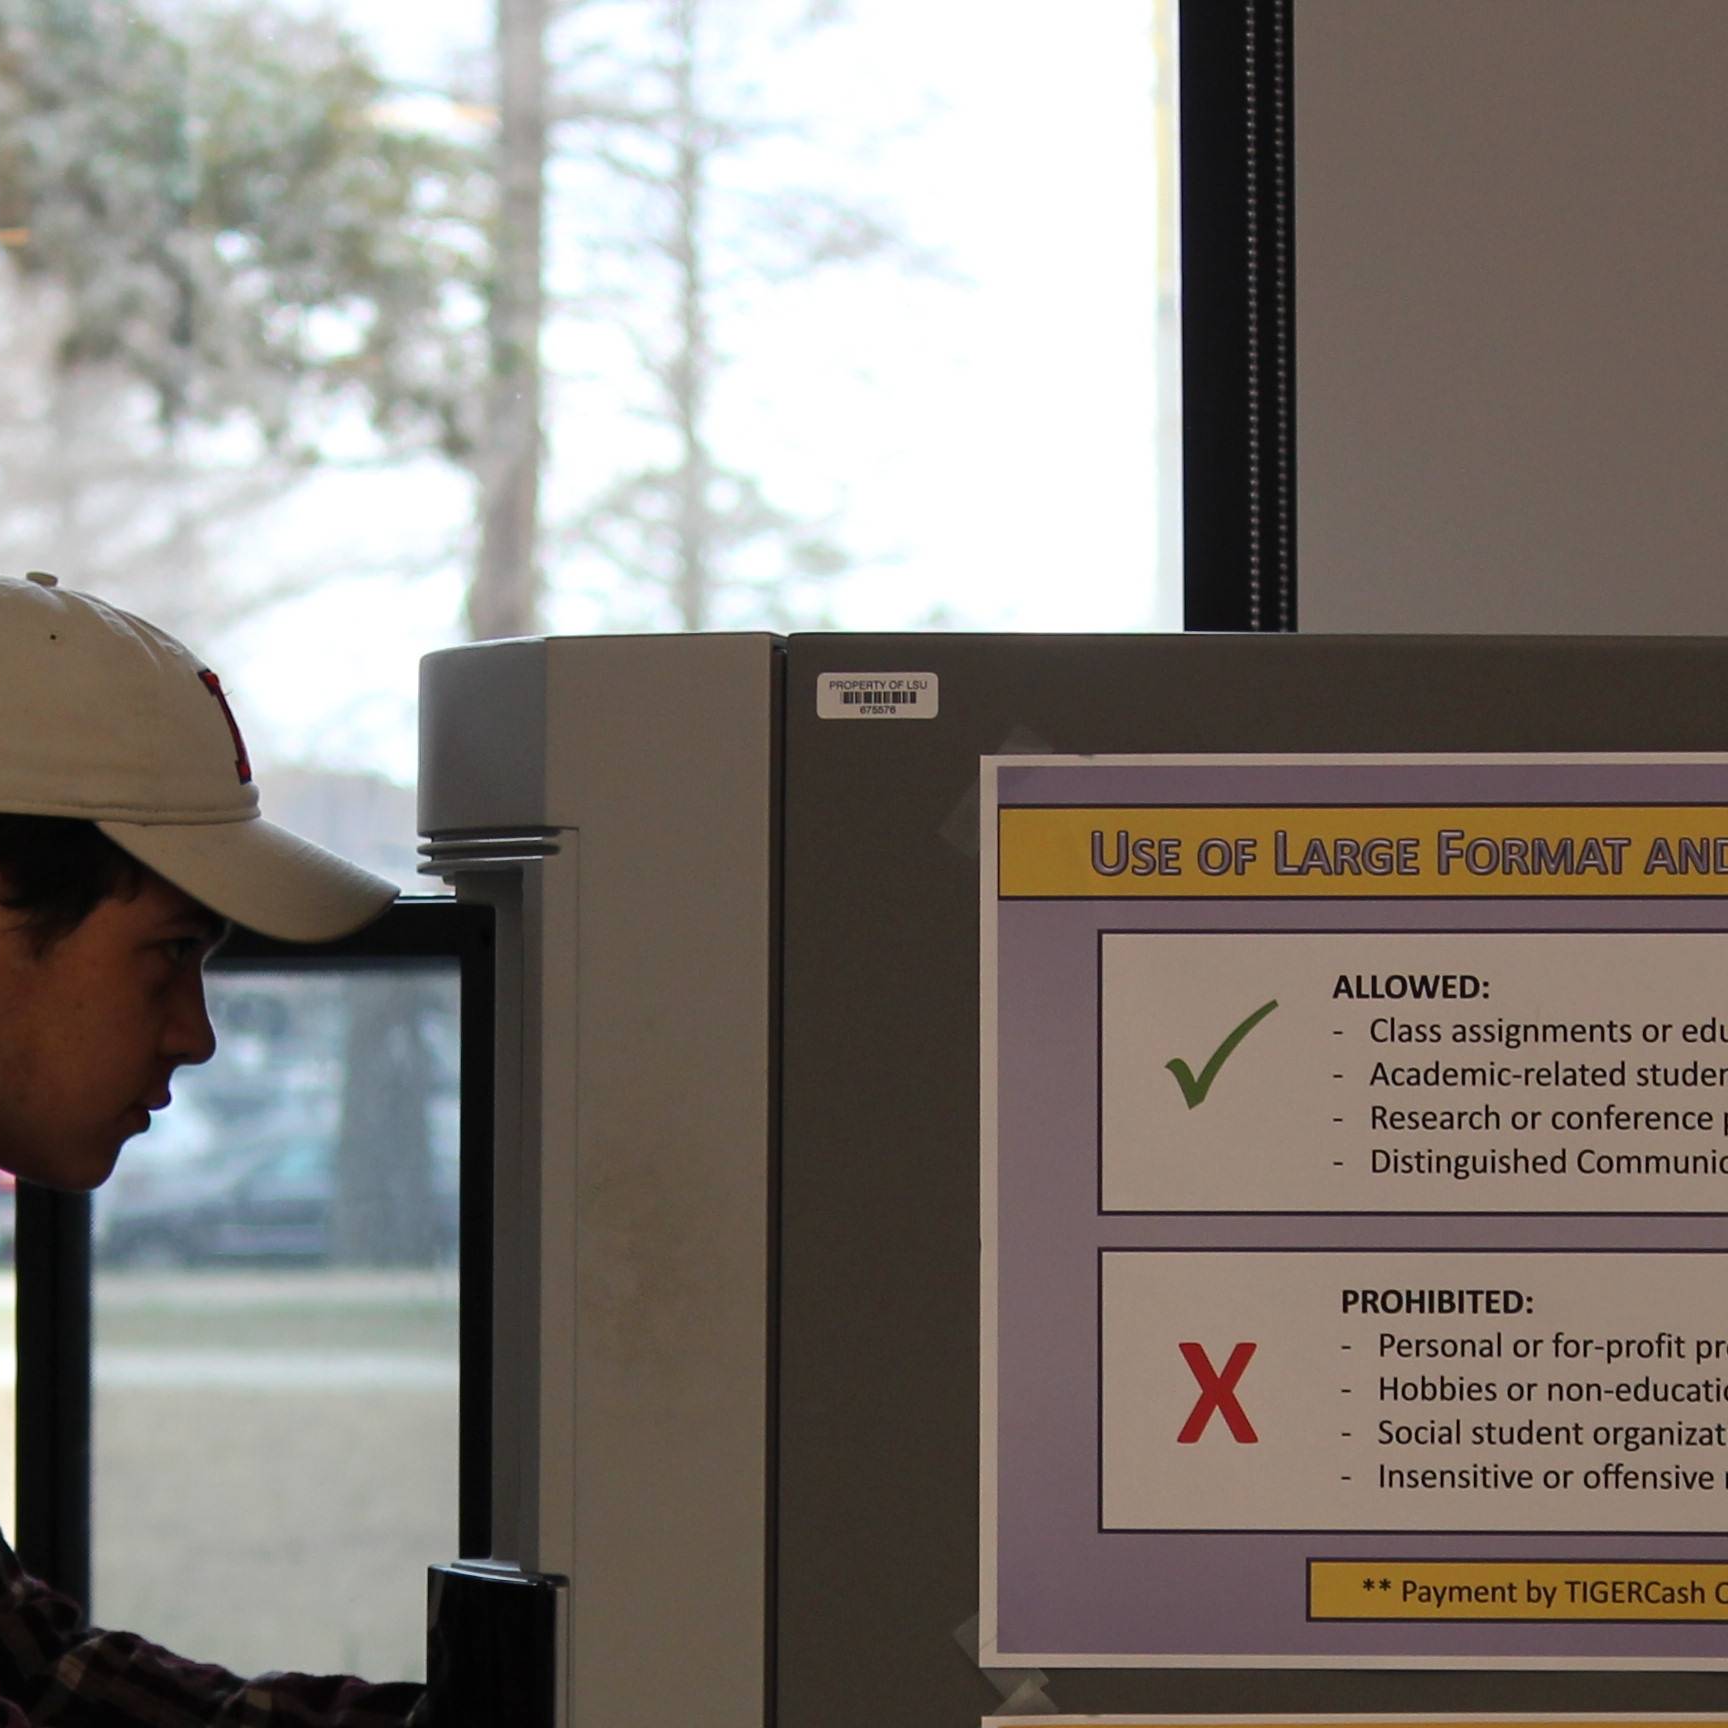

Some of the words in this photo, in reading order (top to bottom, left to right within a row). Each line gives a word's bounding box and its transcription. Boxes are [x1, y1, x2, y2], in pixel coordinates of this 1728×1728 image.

[829, 680, 886, 690] PROPERTY
[889, 680, 903, 690] OF
[906, 680, 928, 690] LSU
[1090, 829, 1182, 877] USE
[1196, 837, 1258, 877] OF
[1274, 829, 1421, 877] LARGE
[1437, 828, 1633, 877] FORMAT
[1332, 974, 1490, 1000] ALLOWED:
[1370, 1016, 1442, 1043] Class
[1451, 1017, 1633, 1050] assignments
[1642, 1023, 1673, 1043] or
[1369, 1060, 1626, 1087] Academic-related
[1371, 1103, 1501, 1131] Research
[1511, 1111, 1543, 1131] or
[1551, 1103, 1714, 1131] conference
[1371, 1147, 1567, 1180] Distinguished
[1342, 1288, 1534, 1315] PROHIBITED:
[1379, 1331, 1502, 1359] Personal
[1512, 1338, 1544, 1358] or
[1551, 1331, 1686, 1365] for-profit
[1379, 1374, 1498, 1402] Hobbies
[1506, 1382, 1539, 1402] or
[1377, 1418, 1461, 1445] Social
[1471, 1418, 1584, 1446] student
[1379, 1463, 1534, 1489] Insensitive
[1543, 1469, 1575, 1490] or
[1583, 1462, 1715, 1491] offensive
[1402, 1579, 1518, 1609] Payment
[1526, 1578, 1558, 1609] by
[1564, 1579, 1706, 1605] TIGERCash
